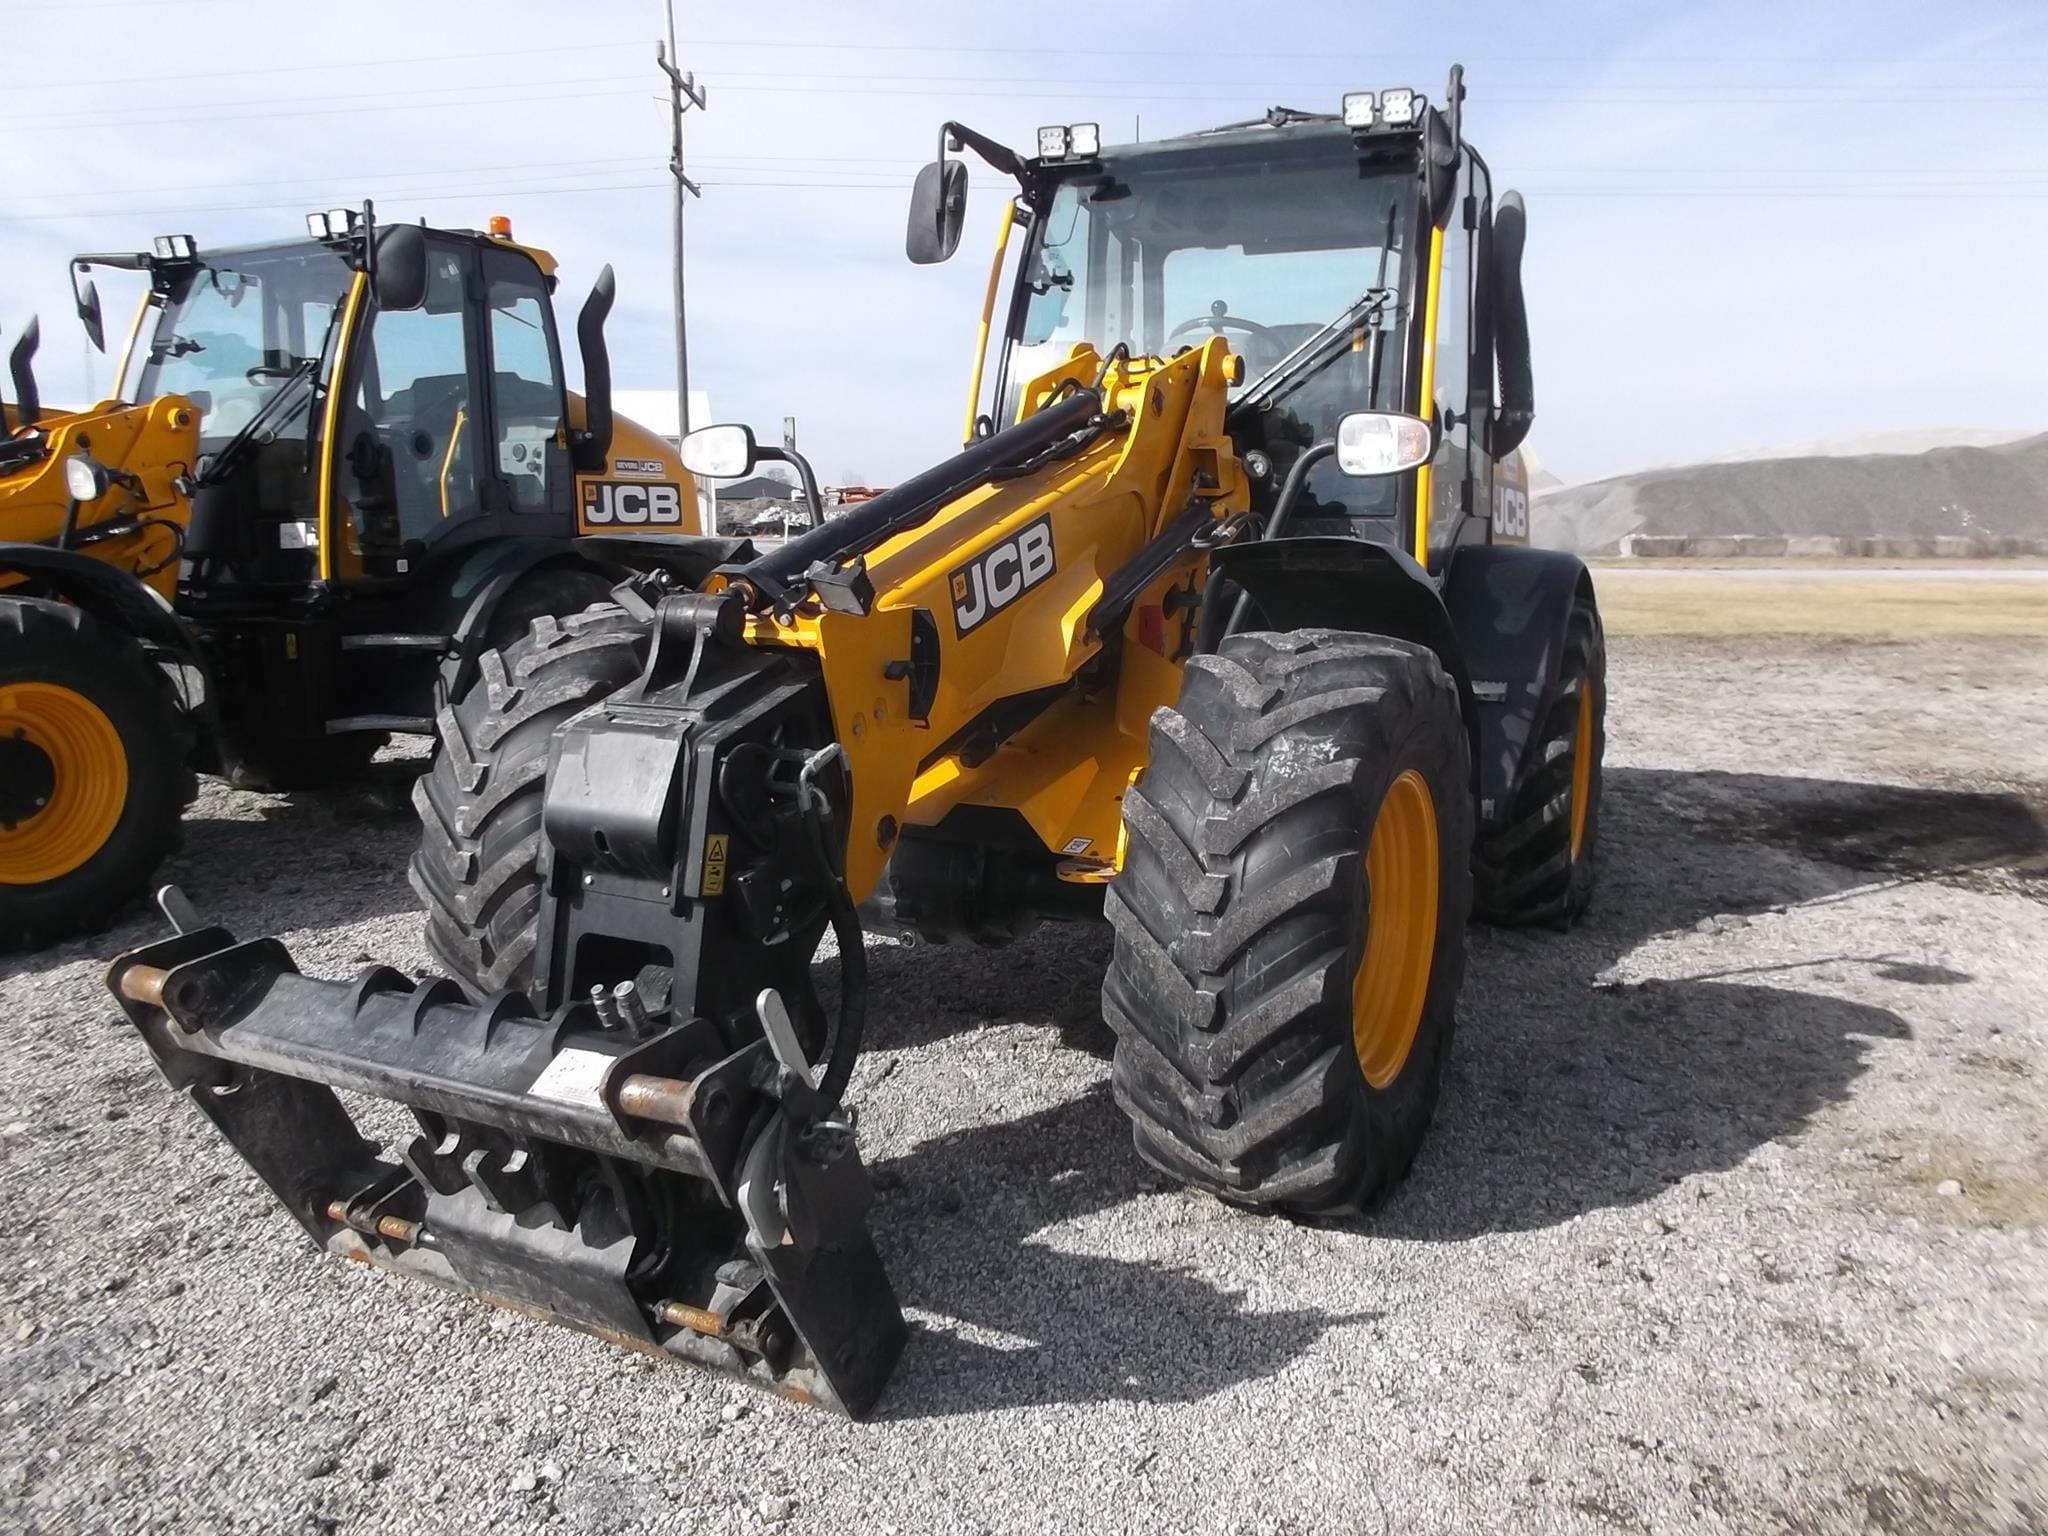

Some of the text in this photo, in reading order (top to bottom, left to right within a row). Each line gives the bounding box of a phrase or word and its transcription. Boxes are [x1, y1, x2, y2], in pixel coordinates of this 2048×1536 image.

[641, 462, 663, 471] JCB
[586, 485, 680, 523] JCB
[1494, 487, 1526, 536] JCB
[957, 522, 1053, 630] JCB
